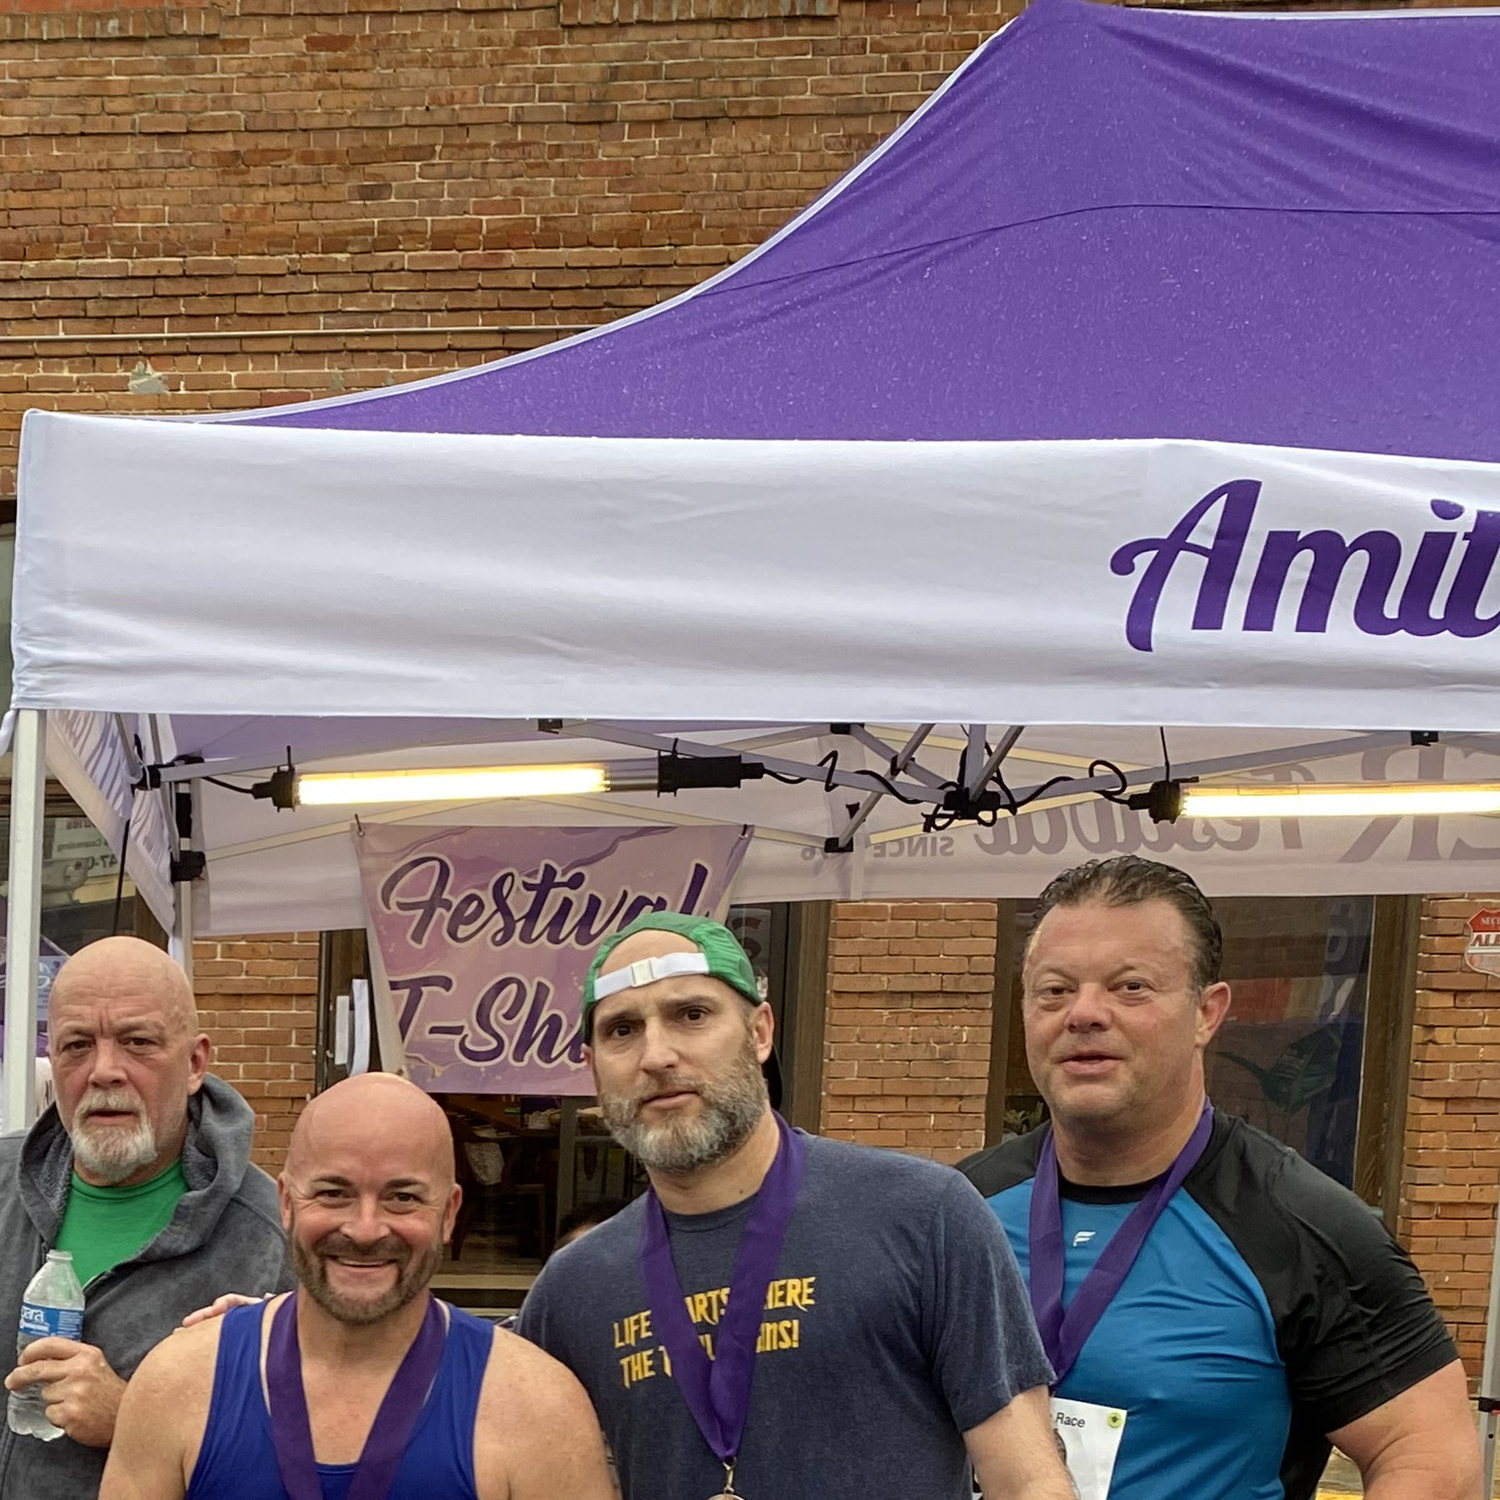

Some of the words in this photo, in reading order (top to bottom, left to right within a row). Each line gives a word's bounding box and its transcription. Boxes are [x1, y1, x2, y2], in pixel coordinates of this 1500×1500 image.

[613, 1309, 653, 1349] LIFE
[619, 1348, 656, 1389] THE
[1055, 1412, 1086, 1428] Race
